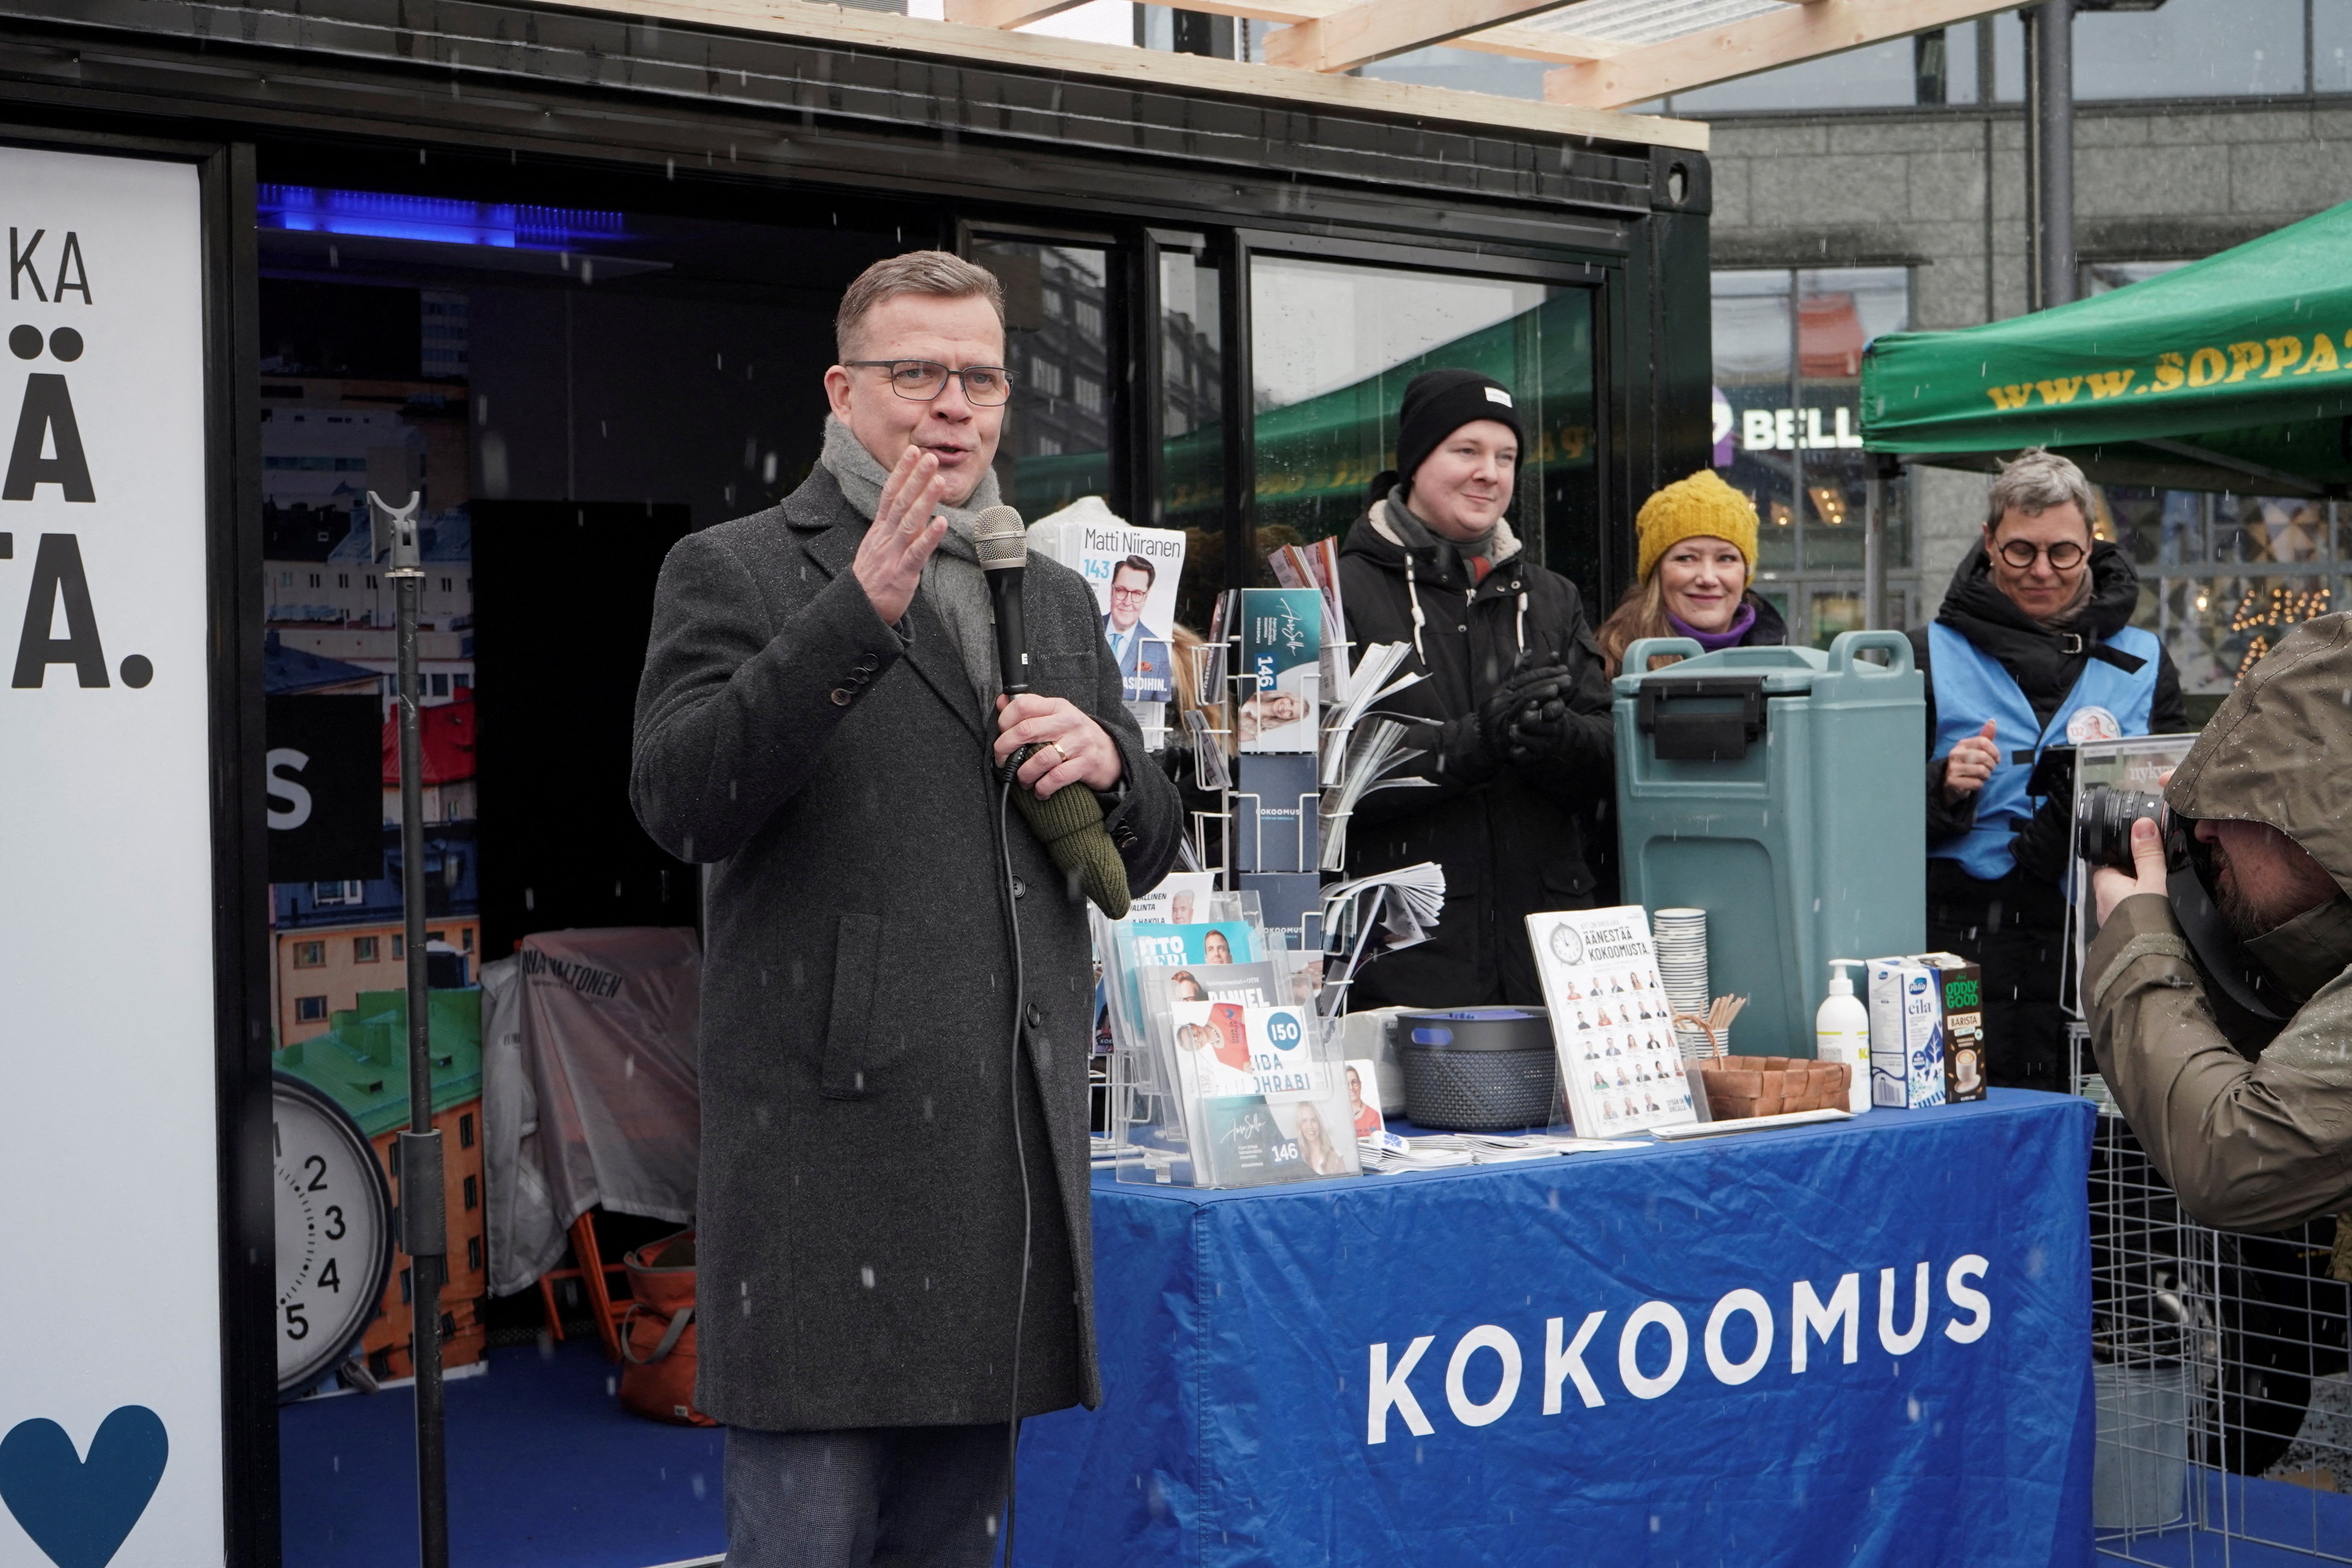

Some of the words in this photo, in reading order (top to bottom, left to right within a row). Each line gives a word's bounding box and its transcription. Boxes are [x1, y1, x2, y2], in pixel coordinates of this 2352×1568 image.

[9, 227, 93, 305] KA
[1085, 528, 1119, 552] Matti
[1123, 532, 1180, 558] Niiranen
[1084, 559, 1110, 579] 143
[0, 532, 154, 689] A.
[1257, 656, 1274, 688] 146
[1583, 926, 1633, 945] ÄÄNESTÄÄ
[1588, 942, 1650, 961] KOKOOMUSTA.
[1909, 983, 1926, 991] Valio
[1909, 999, 1932, 1015] eila
[1946, 993, 1979, 1009] GOOD
[1271, 1023, 1299, 1041] 150
[1951, 1016, 1977, 1027] BARISTA
[1271, 1143, 1298, 1163] 146
[304, 1155, 328, 1192] 2
[325, 1205, 346, 1240] 3
[317, 1257, 340, 1293] 4
[286, 1303, 309, 1340] 5
[1367, 1254, 1991, 1445] KOKOOMUS
